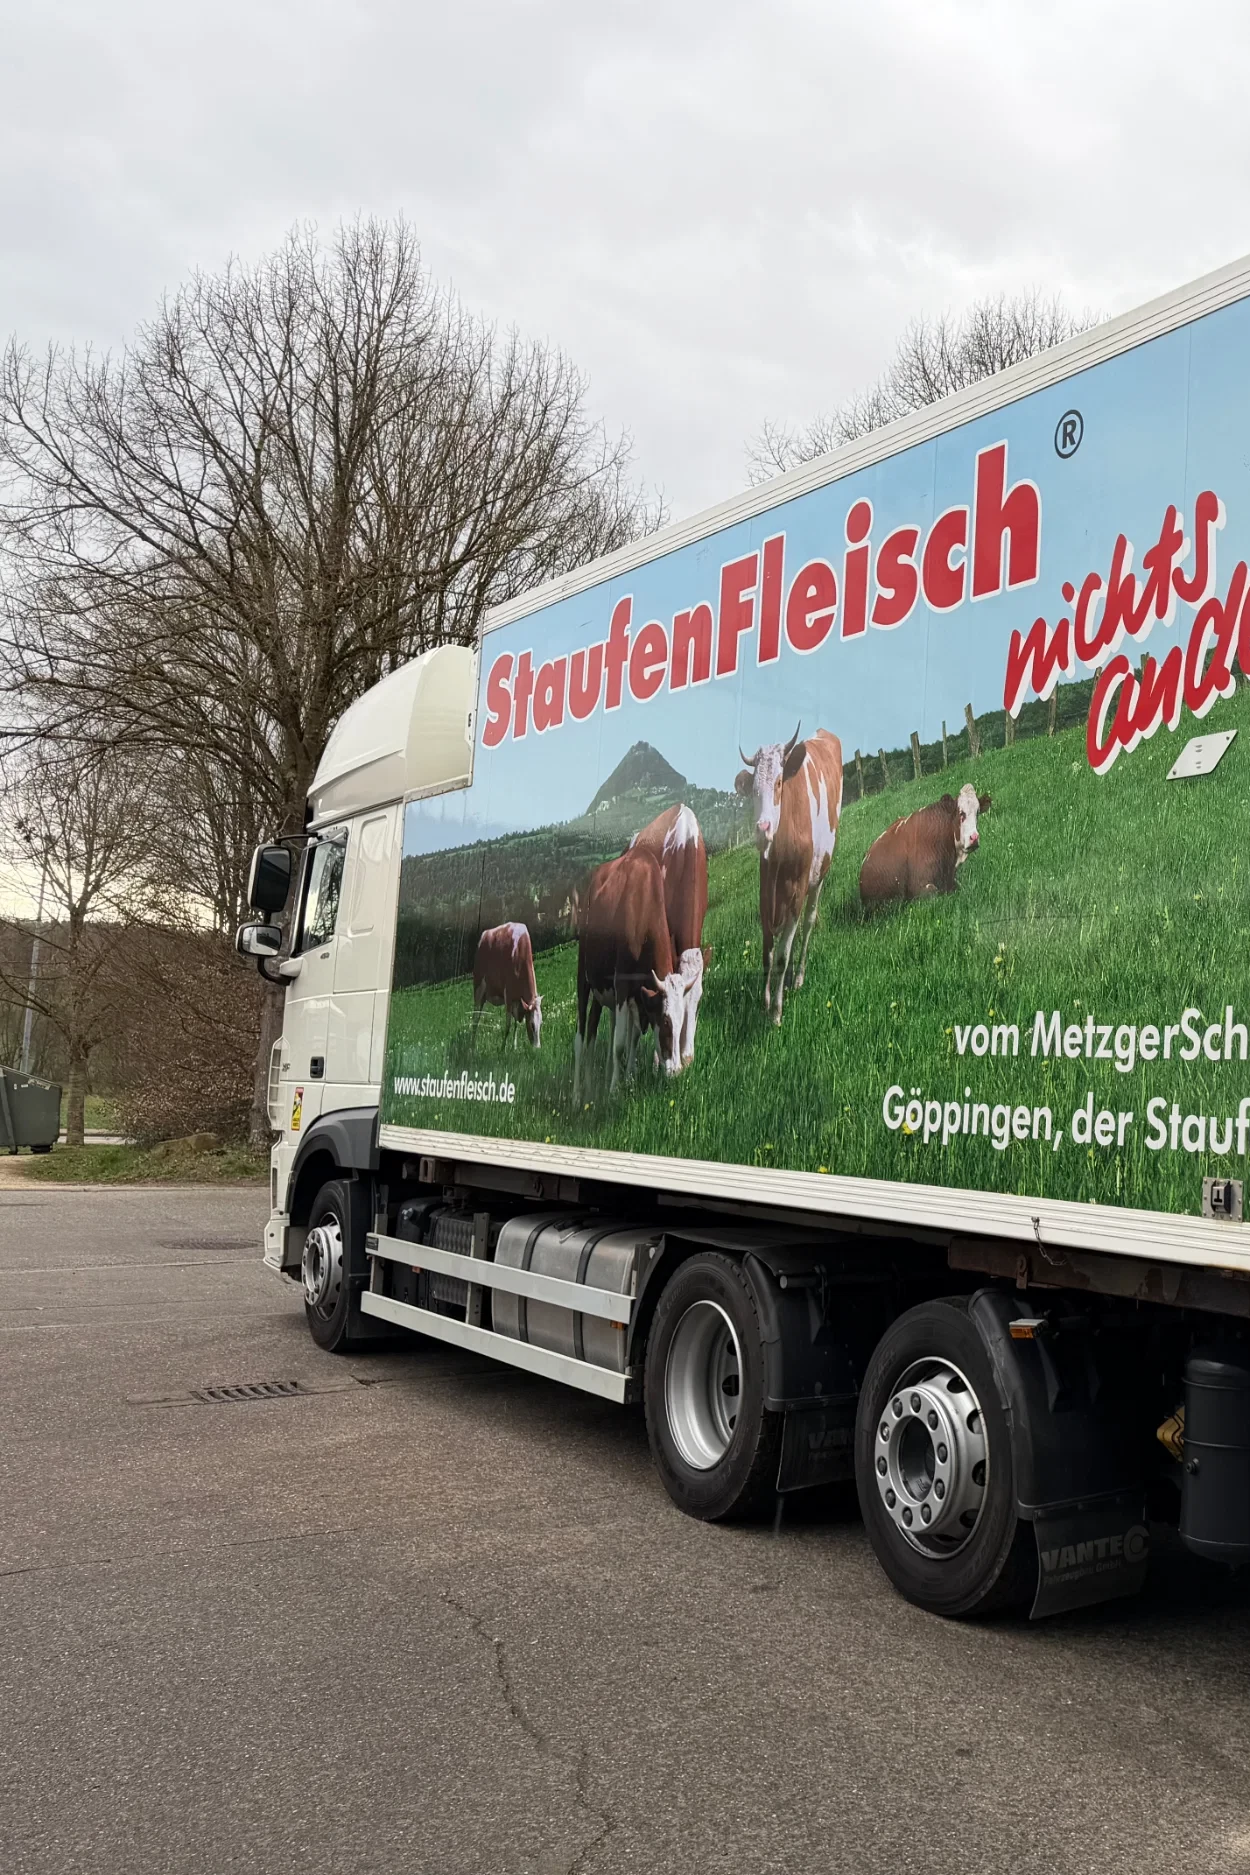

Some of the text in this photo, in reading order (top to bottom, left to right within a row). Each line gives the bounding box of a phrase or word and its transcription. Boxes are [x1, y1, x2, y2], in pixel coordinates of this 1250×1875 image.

[481, 440, 1041, 749] StaufenFleisch
[1003, 490, 1226, 718] nichts
[954, 1024, 1019, 1056] vom
[394, 1070, 516, 1103] www.staufenfleisch.de
[882, 1085, 1063, 1151] Göppingen,
[1071, 1092, 1133, 1146] der
[1040, 1524, 1150, 1572] VANTEC
